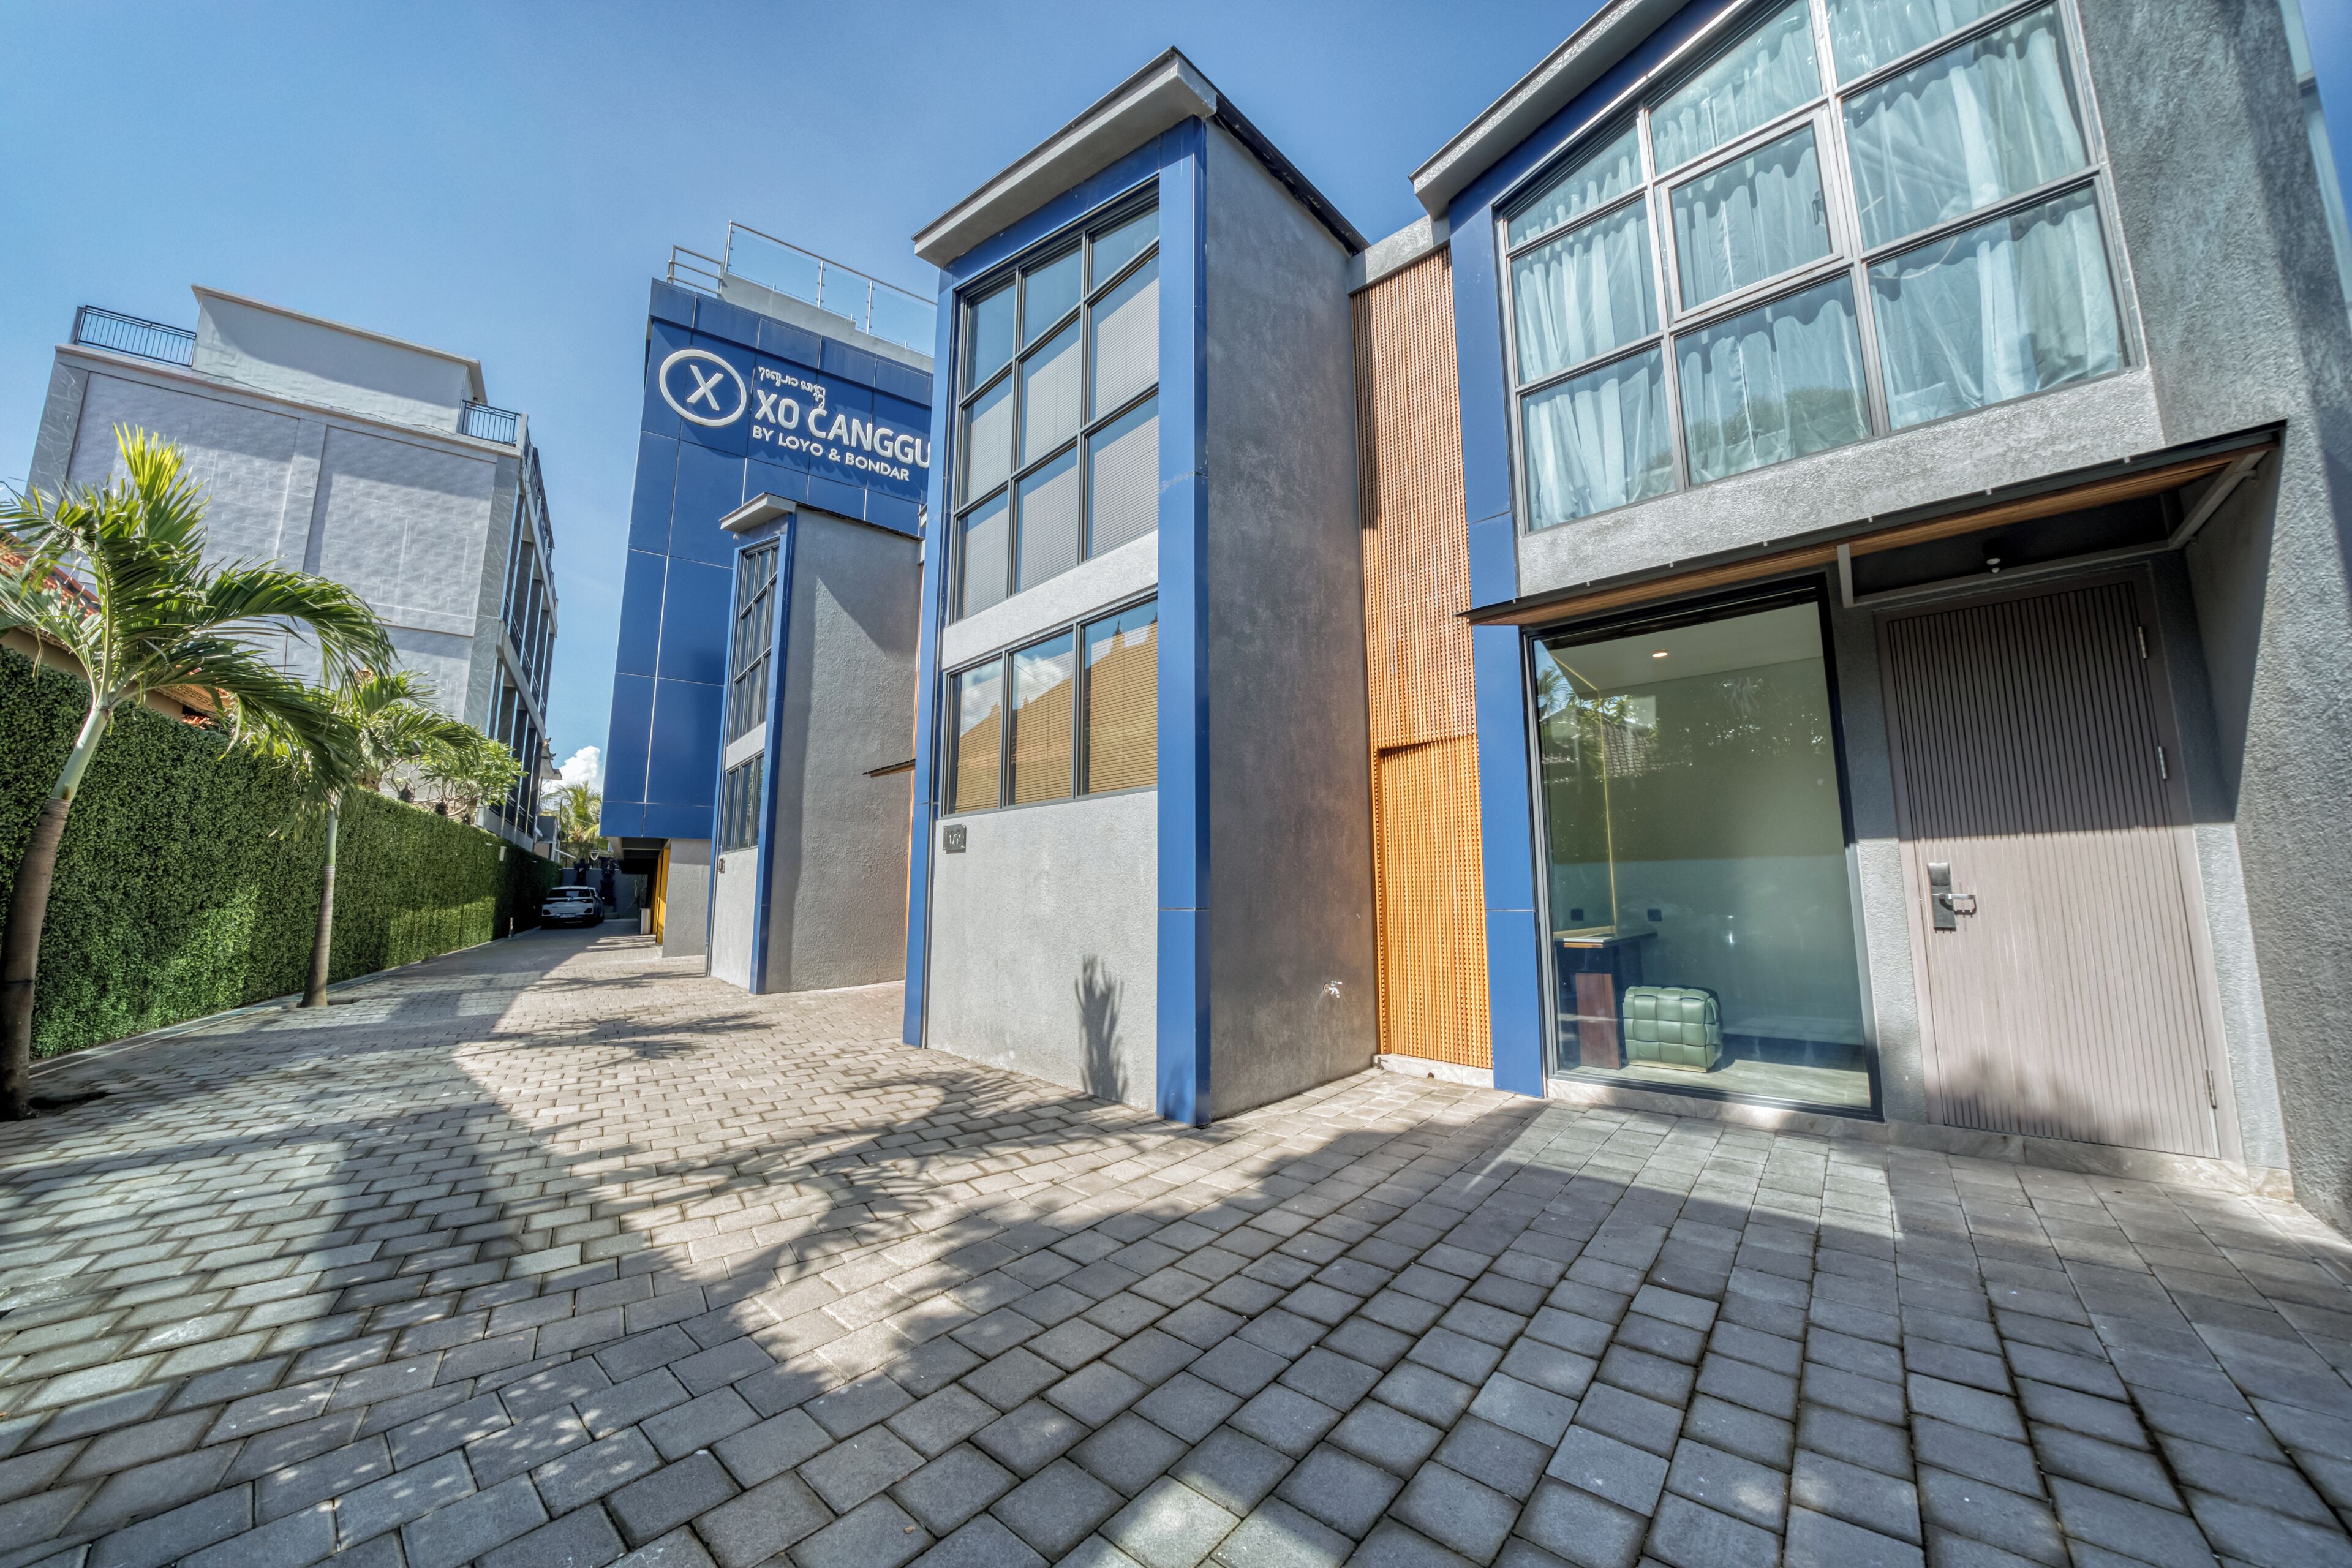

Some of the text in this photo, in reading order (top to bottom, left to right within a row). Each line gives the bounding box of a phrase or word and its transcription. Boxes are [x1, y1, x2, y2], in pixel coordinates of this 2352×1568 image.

[687, 365, 723, 411] X
[752, 425, 910, 481] BY LOYO & BONDAR
[755, 389, 930, 469] XO CANGGU
